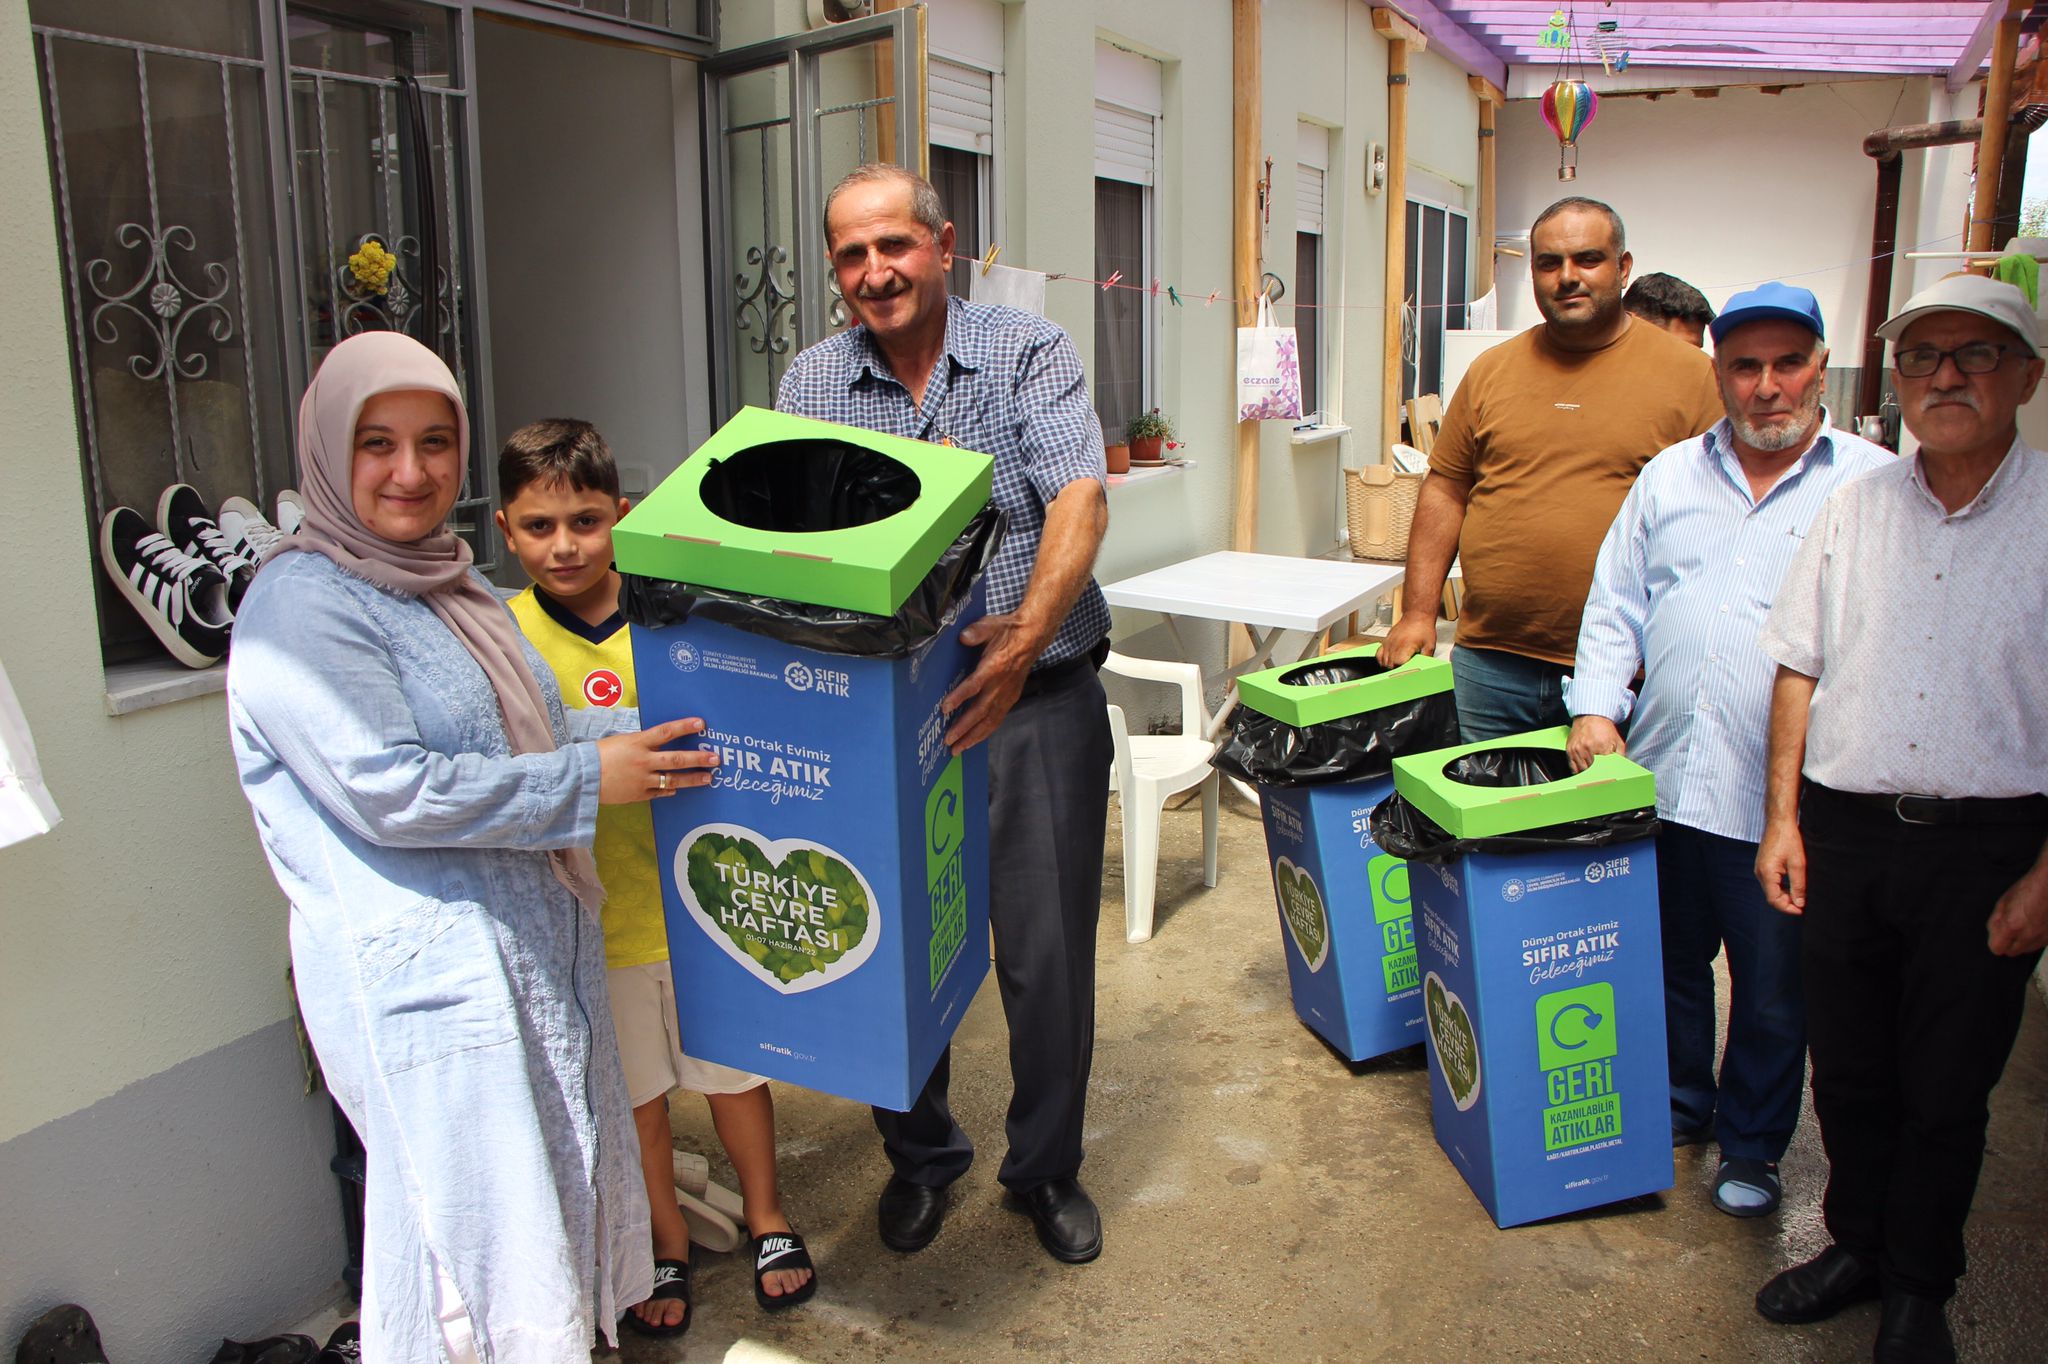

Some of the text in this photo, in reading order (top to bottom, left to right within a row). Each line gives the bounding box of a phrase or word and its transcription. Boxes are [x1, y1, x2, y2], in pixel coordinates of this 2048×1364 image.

[1243, 377, 1280, 385] eczane
[814, 668, 849, 685] SIFIR
[815, 681, 850, 698] ATIK
[698, 728, 831, 763] Dünya Ortak Evimiz
[919, 717, 941, 766] SIFIR
[708, 767, 824, 805] Geleceğimiz
[769, 757, 831, 787] ATIK
[1605, 857, 1630, 869] SIFIR
[1606, 865, 1631, 879] ATIK
[714, 862, 838, 908] TÜRKİYE
[932, 847, 963, 932] GERİ
[731, 888, 826, 927] ÇEVRE
[720, 906, 839, 951] HAFTASI
[745, 934, 767, 945] 01-07
[1383, 916, 1416, 953] GE
[1522, 920, 1619, 948] Dünya Ortak Evimiz
[1522, 931, 1619, 967] SIFIR ATIK
[1391, 965, 1419, 989] ATIK
[1529, 950, 1615, 985] Geleceğimiz
[1547, 1058, 1613, 1105] GERİ
[1550, 1099, 1614, 1125] KAZANILABİLİR
[1552, 1114, 1615, 1145] ATIKLAR
[762, 1237, 793, 1255] NIKE
[653, 1266, 678, 1282] IKE
